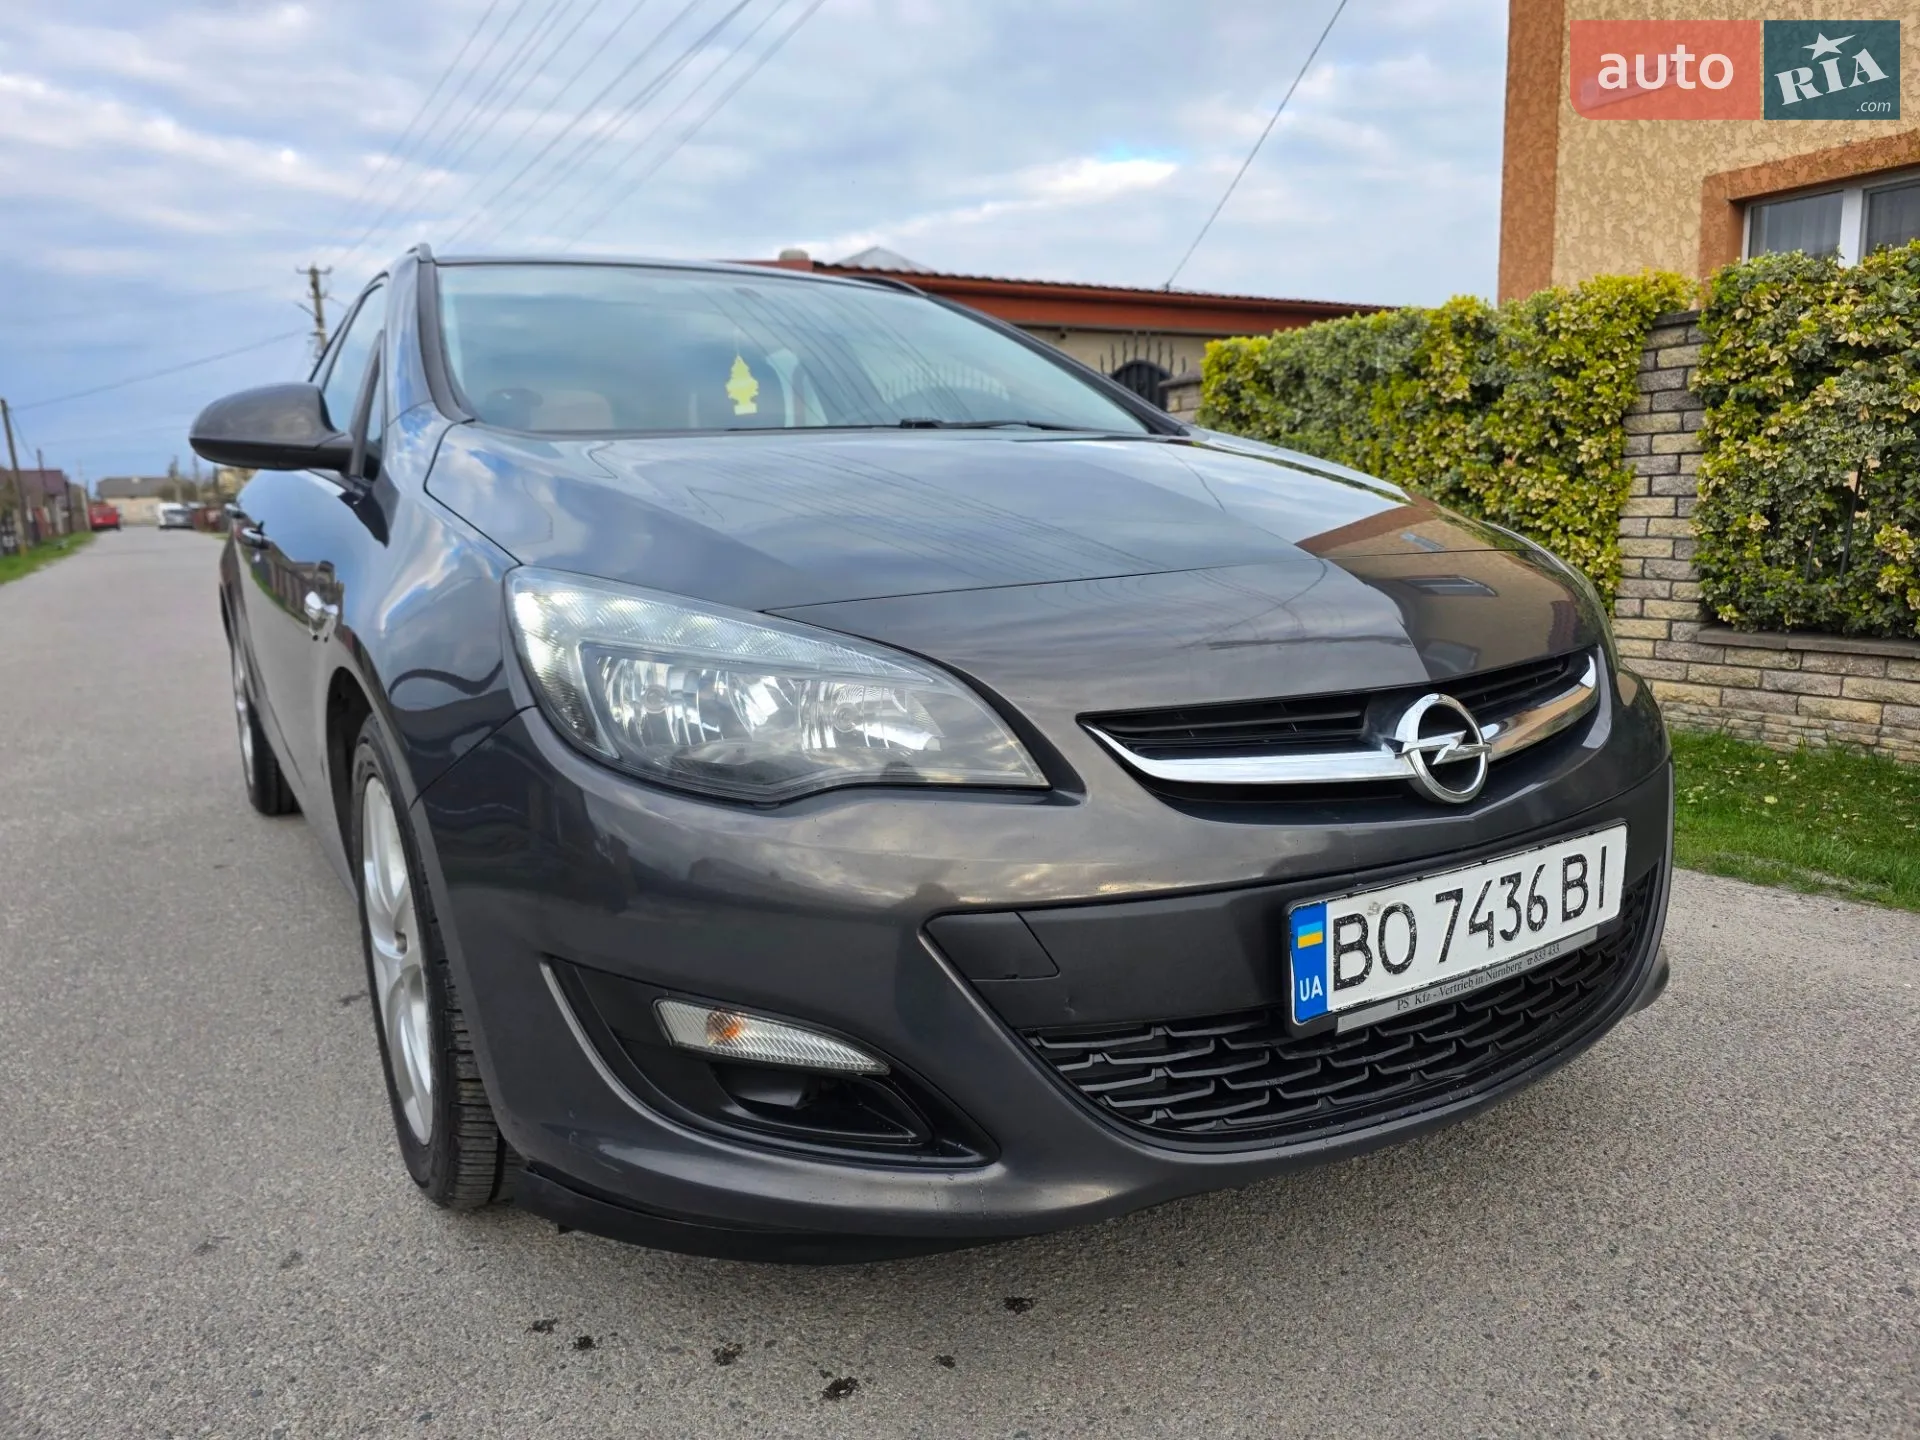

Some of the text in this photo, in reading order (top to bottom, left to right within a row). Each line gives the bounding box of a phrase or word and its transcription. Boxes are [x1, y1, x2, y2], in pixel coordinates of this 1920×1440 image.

[1333, 845, 1607, 992] BO 7436 BI
[1299, 975, 1323, 1002] UA
[1397, 998, 1410, 1011] PS
[1440, 976, 1474, 997] Vertrieb
